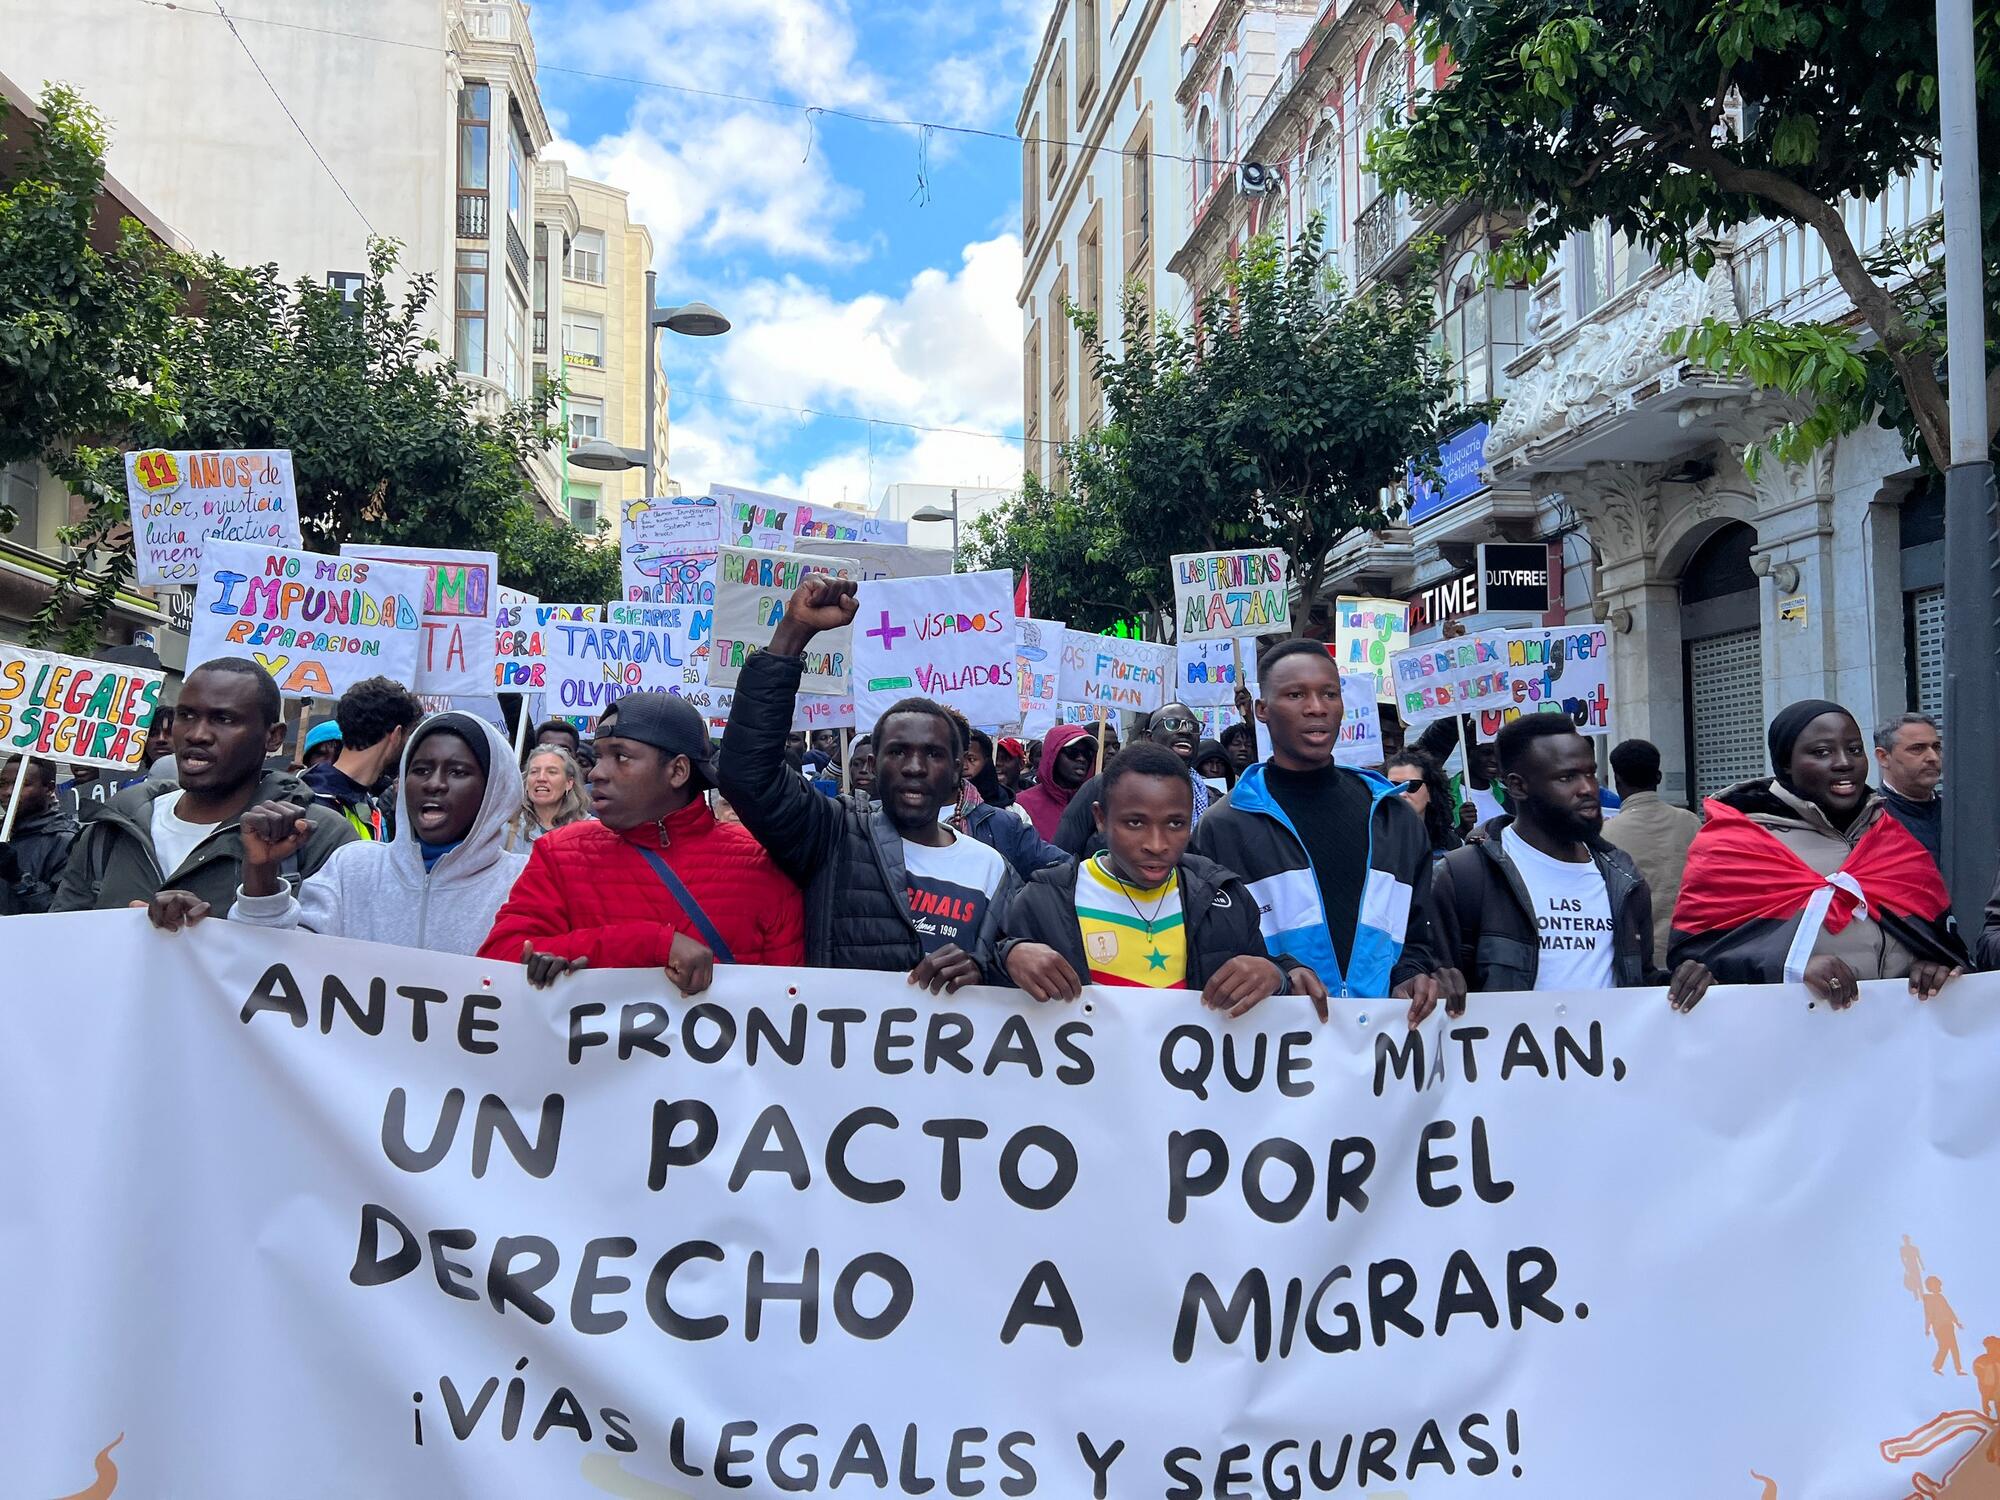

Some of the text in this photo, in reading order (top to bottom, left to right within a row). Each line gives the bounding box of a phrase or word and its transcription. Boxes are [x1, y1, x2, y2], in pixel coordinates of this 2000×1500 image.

[140, 452, 281, 489] 11 AÑOS de
[141, 486, 286, 524] dolor, injusticia
[731, 499, 788, 535] inguna
[145, 515, 286, 545] lucha colectiva
[150, 546, 202, 564] mem
[158, 563, 200, 579] res
[265, 555, 370, 584] NO MAS
[659, 565, 701, 584] NO
[1180, 553, 1282, 591] LAS FRONTERAS
[1486, 570, 1548, 586] DUTYFREE
[209, 570, 419, 631] IMPUNIDAD
[758, 597, 787, 627] PA
[1183, 588, 1288, 634] MATAN
[225, 619, 381, 656] REPARACION
[1336, 601, 1408, 643] Tarajal
[555, 625, 683, 668] TARAJAL
[1199, 642, 1232, 659] y no
[1350, 638, 1386, 666] NO
[252, 652, 334, 695] YA
[603, 662, 642, 685] NO
[915, 660, 1013, 695] VALLADOS
[1399, 653, 1434, 681] PAS
[1435, 649, 1457, 673] DE
[29, 664, 161, 728] LEGALES
[1084, 680, 1142, 707] MATAN
[1435, 682, 1456, 705] DE
[1511, 665, 1552, 704] est
[802, 703, 831, 723] que
[12, 707, 148, 763] SEGURAS
[1549, 897, 1582, 912] LAS
[940, 924, 957, 938] 1990
[1536, 916, 1615, 931] ONTERAS
[1538, 935, 1596, 951] MATAN
[239, 963, 1628, 1100] ANTE FRONTERAS QUE MATAN,
[380, 1087, 1514, 1224] UN PACTO POR EL
[349, 1203, 1590, 1364] DERECHO A MIGRAR.
[411, 1356, 1523, 1500] ¡VÍAS LEGALES Y SEGURAS!
